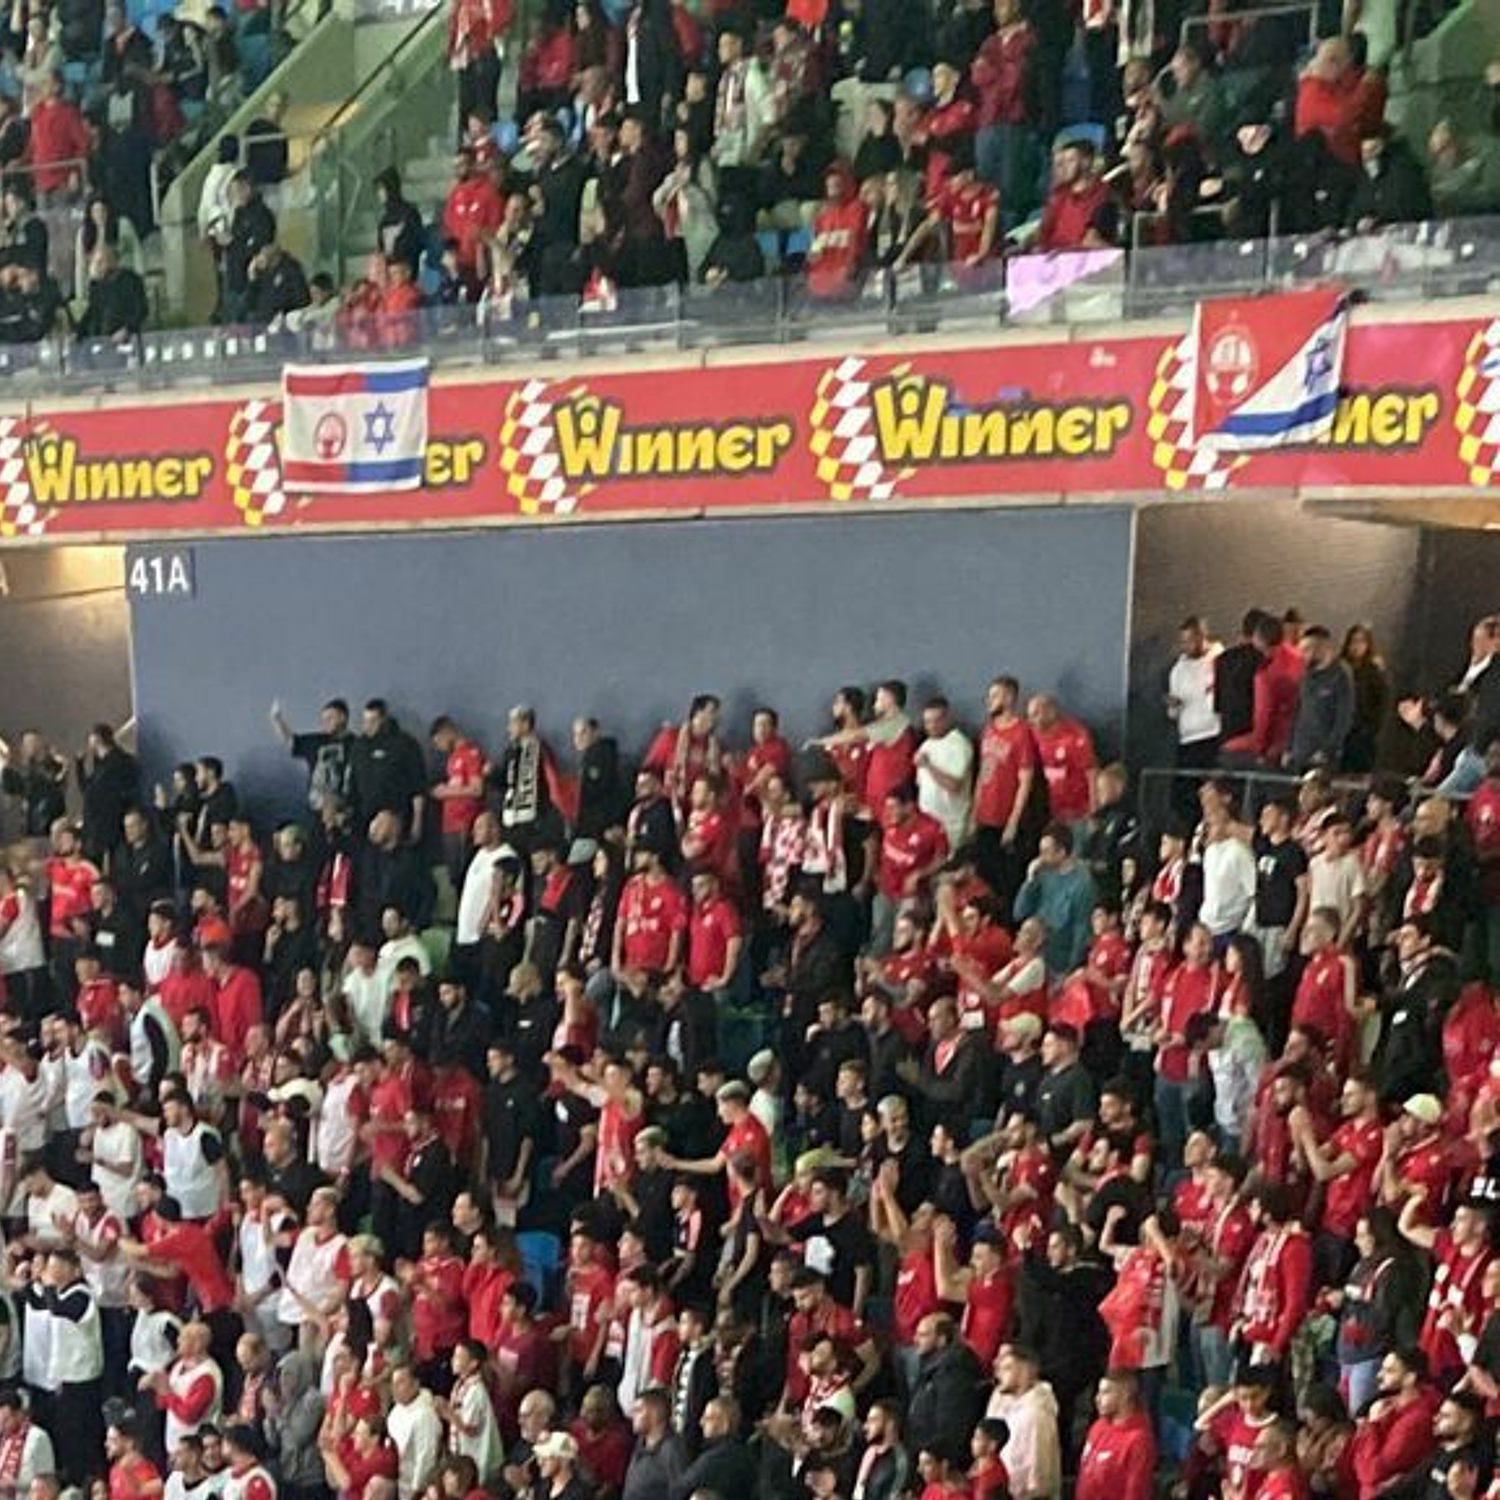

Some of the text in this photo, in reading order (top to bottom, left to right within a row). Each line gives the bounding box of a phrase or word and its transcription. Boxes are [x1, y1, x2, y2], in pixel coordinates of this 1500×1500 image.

[555, 390, 793, 477] Winner
[874, 367, 1131, 460] Winner
[1333, 392, 1439, 446] ner
[25, 434, 213, 504] Winner
[127, 556, 189, 594] 41A
